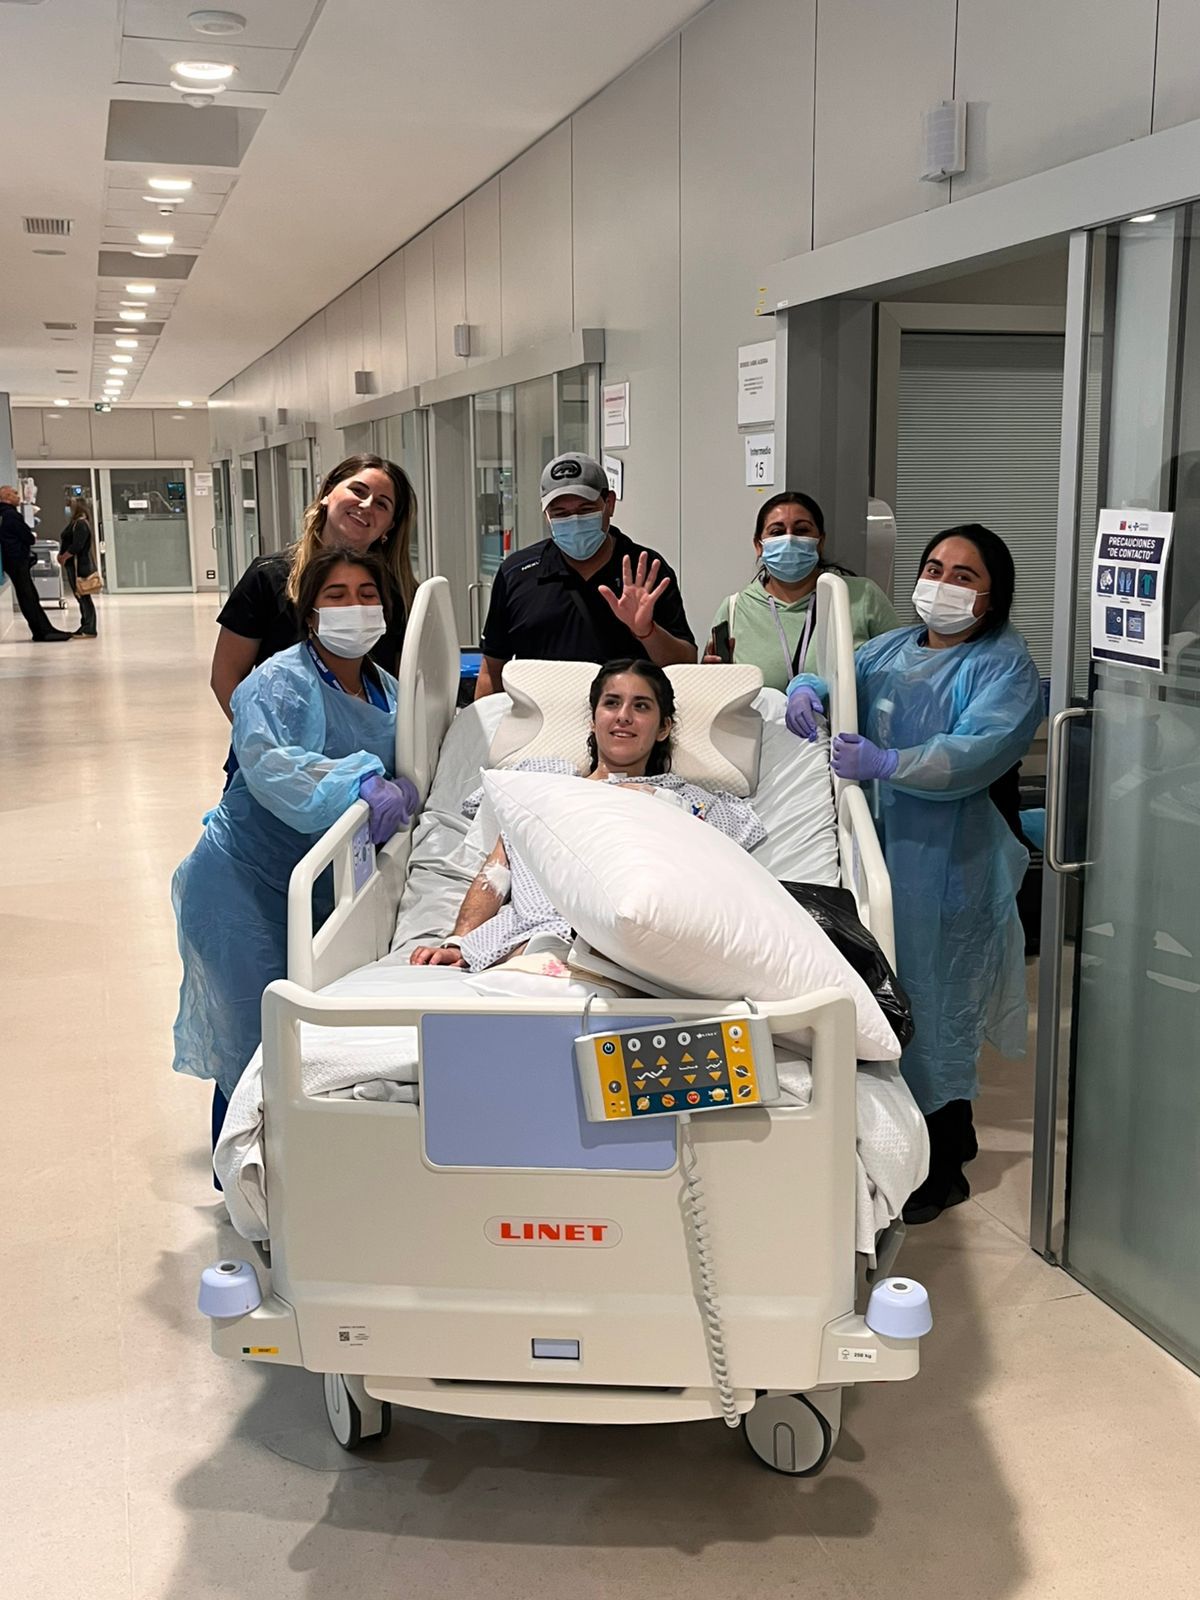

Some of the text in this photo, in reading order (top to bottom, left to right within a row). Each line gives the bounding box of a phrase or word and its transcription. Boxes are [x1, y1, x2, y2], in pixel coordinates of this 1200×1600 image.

[755, 461, 764, 478] 15
[1108, 536, 1155, 549] PRECAUCIONES
[501, 1222, 608, 1241] LINET
